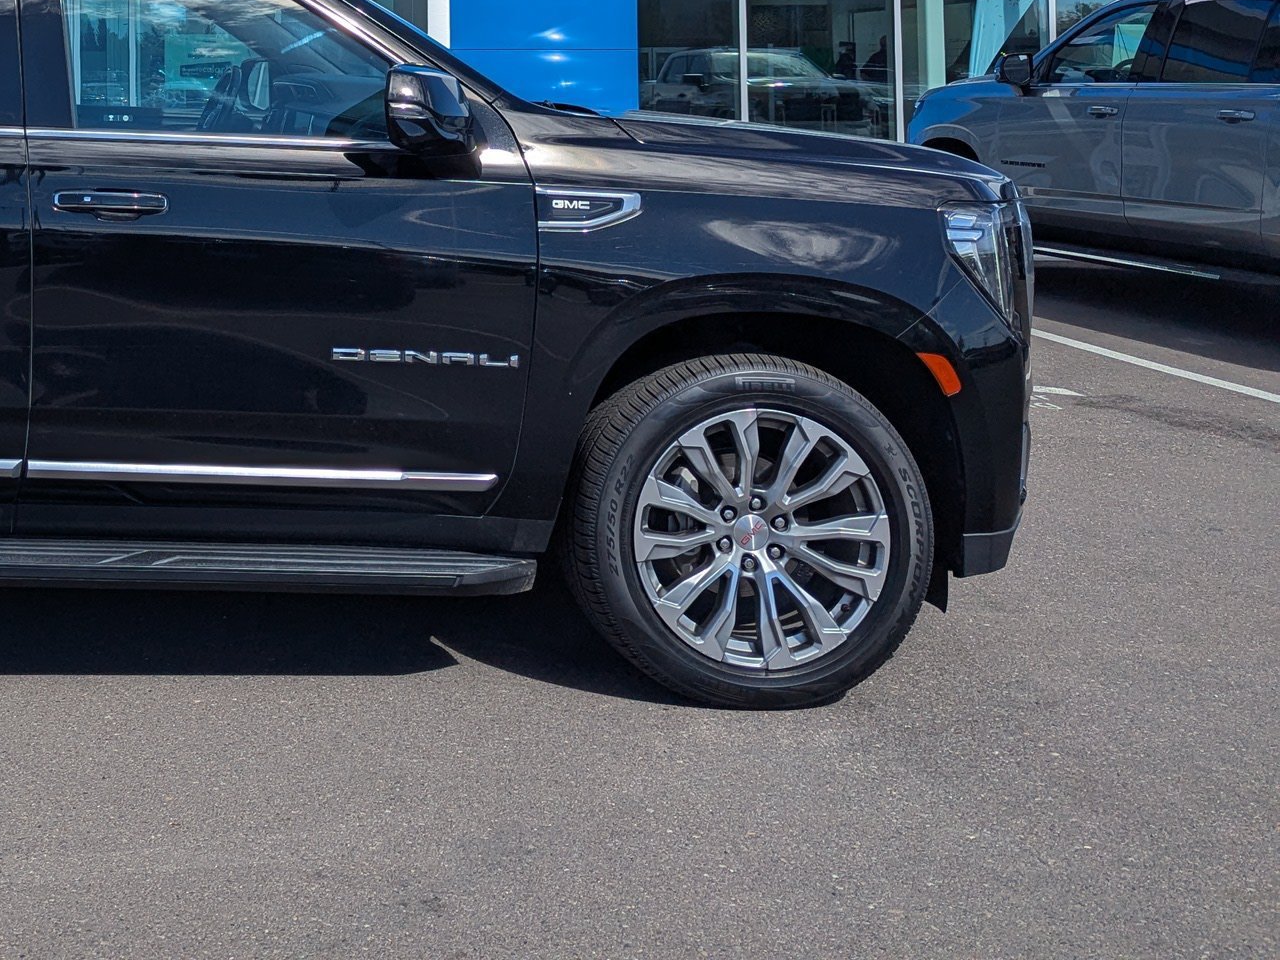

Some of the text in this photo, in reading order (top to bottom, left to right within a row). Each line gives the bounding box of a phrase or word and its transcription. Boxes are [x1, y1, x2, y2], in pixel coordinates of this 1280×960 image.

[552, 199, 590, 210] GMC
[331, 347, 519, 369] DENALI
[740, 520, 764, 546] GMC
